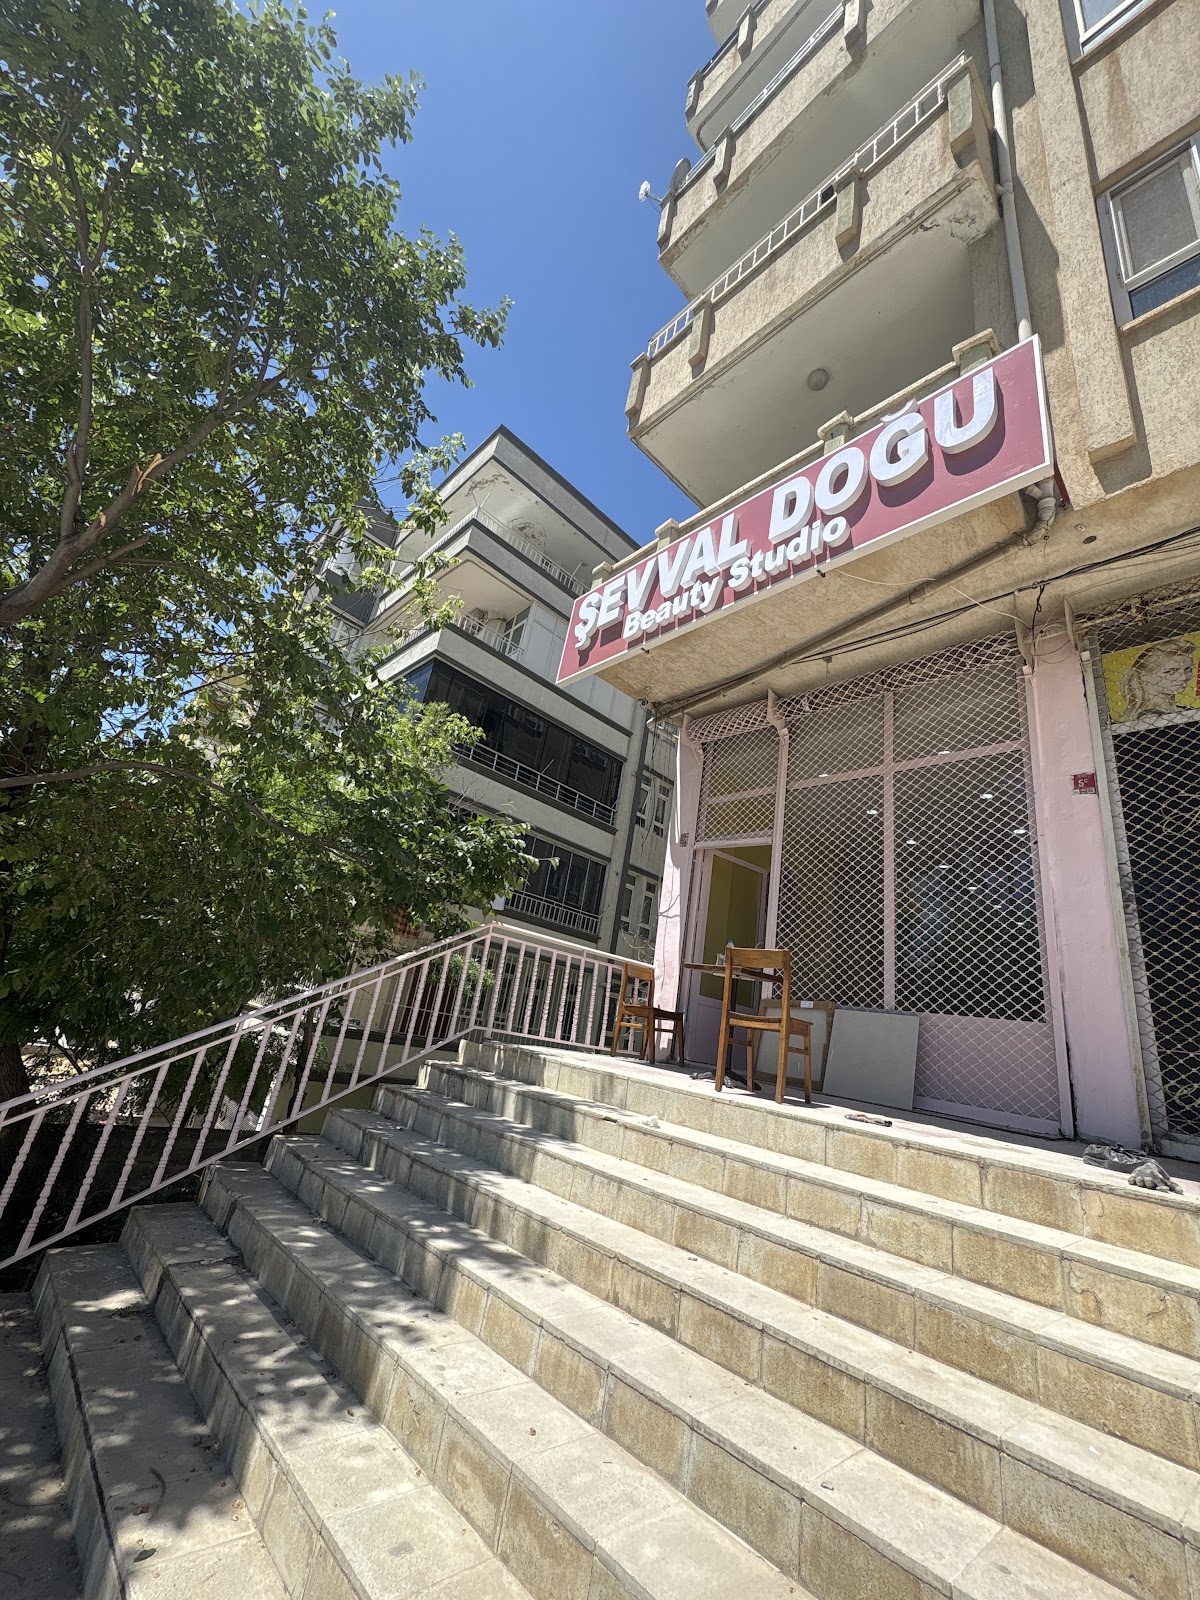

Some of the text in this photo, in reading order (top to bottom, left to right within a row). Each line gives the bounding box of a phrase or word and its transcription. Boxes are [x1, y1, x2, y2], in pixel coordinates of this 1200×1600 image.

[574, 367, 997, 649] ŞEVVAL DOĞU
[622, 516, 849, 641] Beauty Studio
